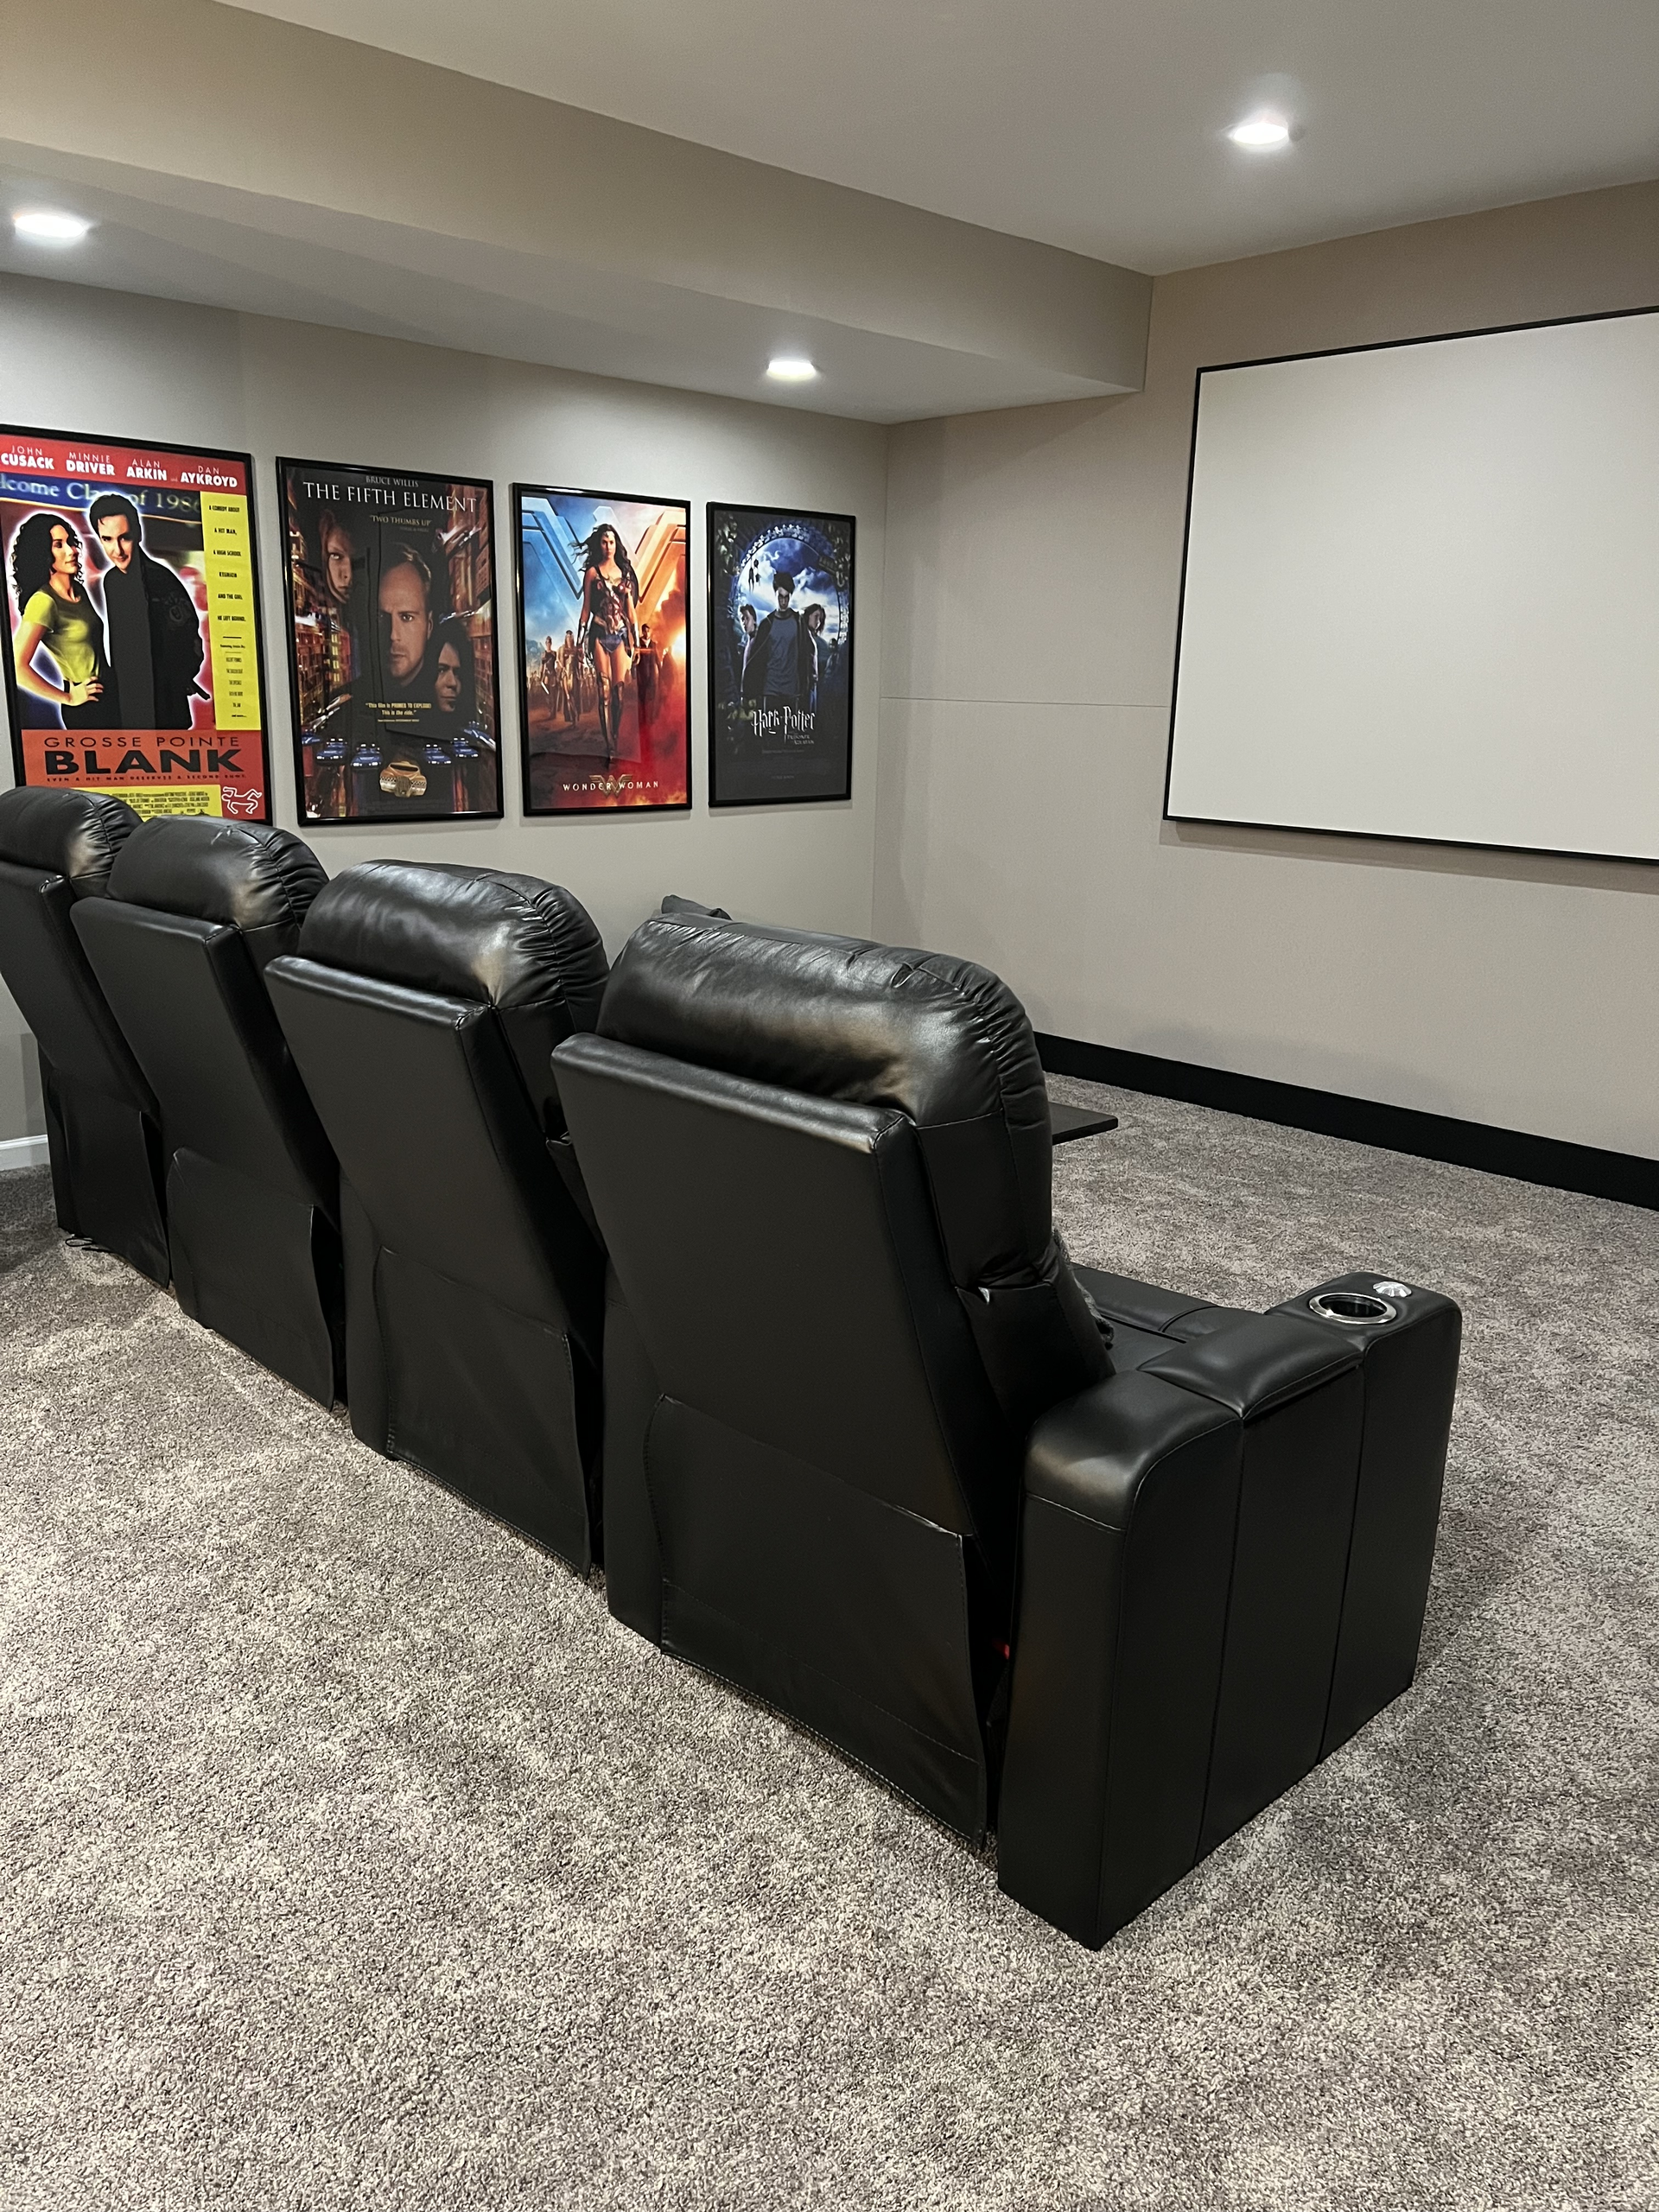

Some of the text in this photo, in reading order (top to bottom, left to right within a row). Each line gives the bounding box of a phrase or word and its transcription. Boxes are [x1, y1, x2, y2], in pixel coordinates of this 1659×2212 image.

[11, 445, 42, 456] JOHN
[69, 452, 111, 463] MINNIE
[1, 453, 54, 470] CUSACK
[66, 460, 115, 475] DRIVER
[132, 459, 160, 468] ALAN
[126, 466, 167, 481] ARKIN
[198, 465, 219, 474] DAN
[181, 472, 238, 487] AYKROYD
[365, 475, 419, 488] BRUCE WILLIS
[130, 489, 149, 505] of
[302, 481, 477, 513] THE FIFTH ELEMENT
[391, 516, 420, 526] THUMBS
[750, 705, 816, 741] Harry Potter
[44, 736, 239, 748] GROSSE POINTE
[44, 748, 245, 775] BLANK
[563, 781, 658, 791] WONDER WOMAN
